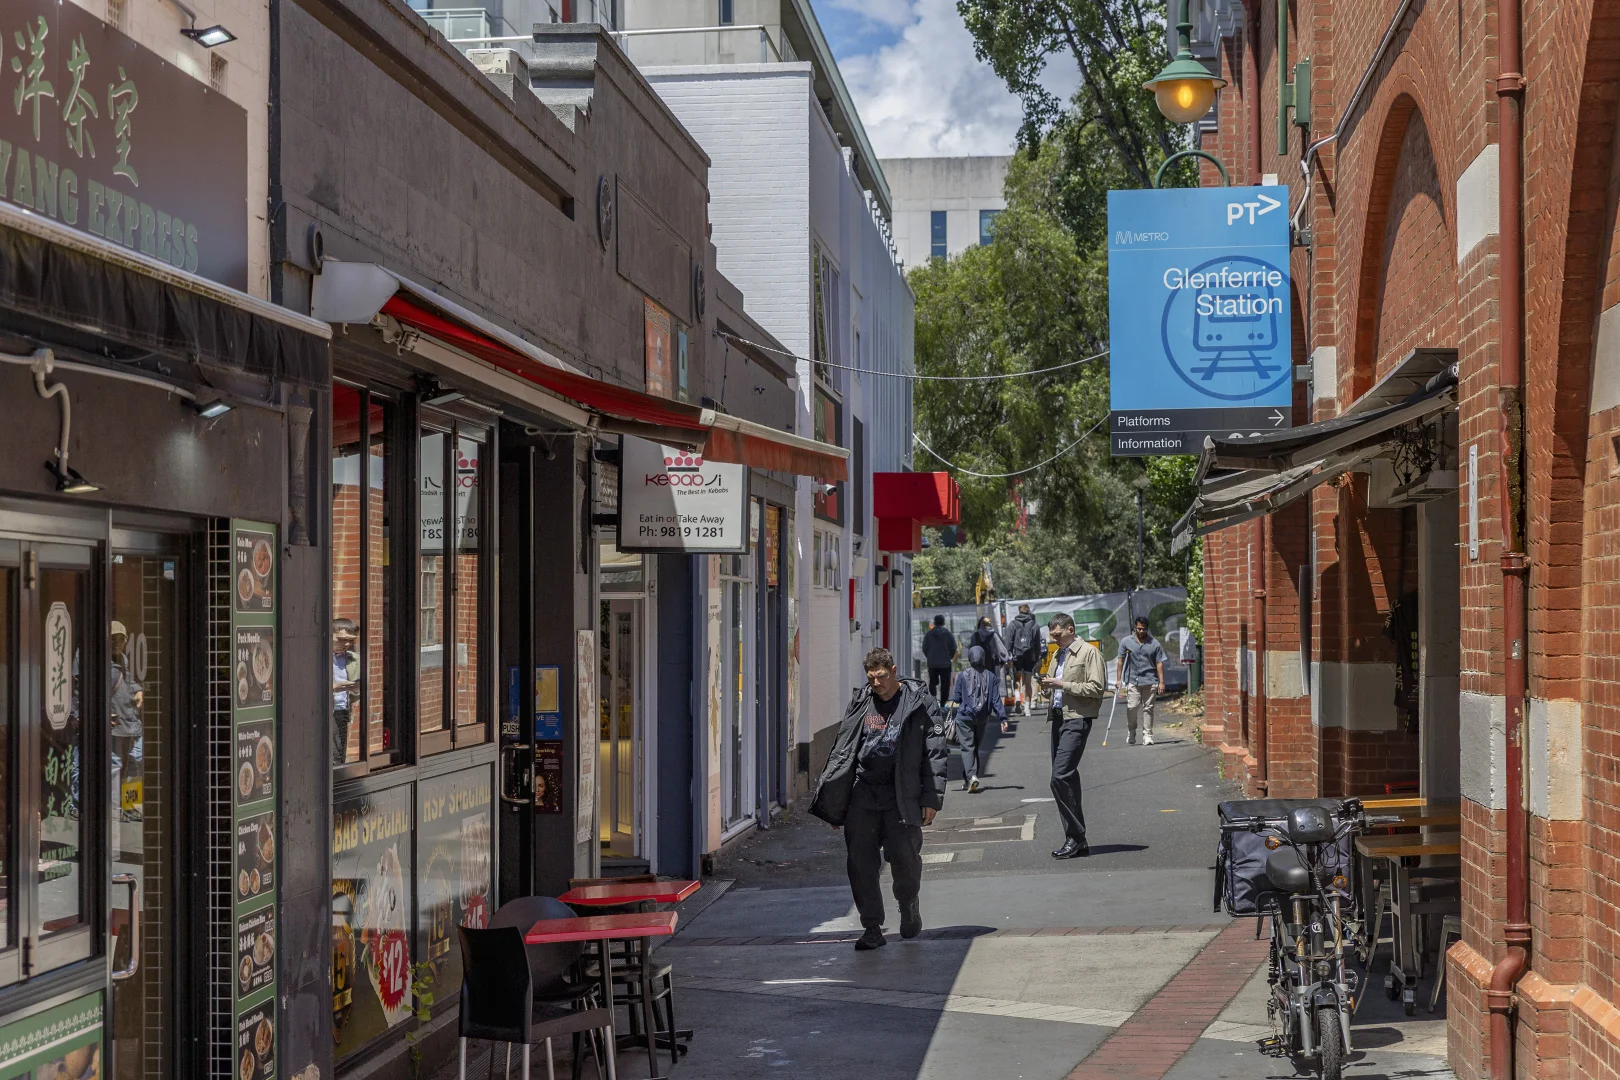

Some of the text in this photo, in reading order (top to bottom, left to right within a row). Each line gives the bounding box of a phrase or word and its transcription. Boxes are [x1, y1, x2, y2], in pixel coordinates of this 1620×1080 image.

[0, 15, 139, 187] 洋茶室
[88, 178, 199, 274] EXPRESS
[1133, 232, 1169, 242] METRO
[1163, 266, 1282, 290] Glenferrie
[1196, 293, 1283, 316] Station
[1117, 415, 1171, 428] Platforms
[1117, 438, 1182, 449] Information
[639, 514, 653, 523] Eat
[656, 514, 664, 523] in
[678, 514, 698, 523] Take
[700, 514, 725, 525] Away
[639, 526, 723, 537] Ph: 9819 1281
[52, 614, 67, 702] 南洋
[503, 725, 520, 733] PUSH
[125, 789, 139, 803] OPEN
[423, 781, 491, 823] HSP SPECIAL
[332, 806, 408, 854] BAB SPECIAL
[383, 939, 403, 995] $12
